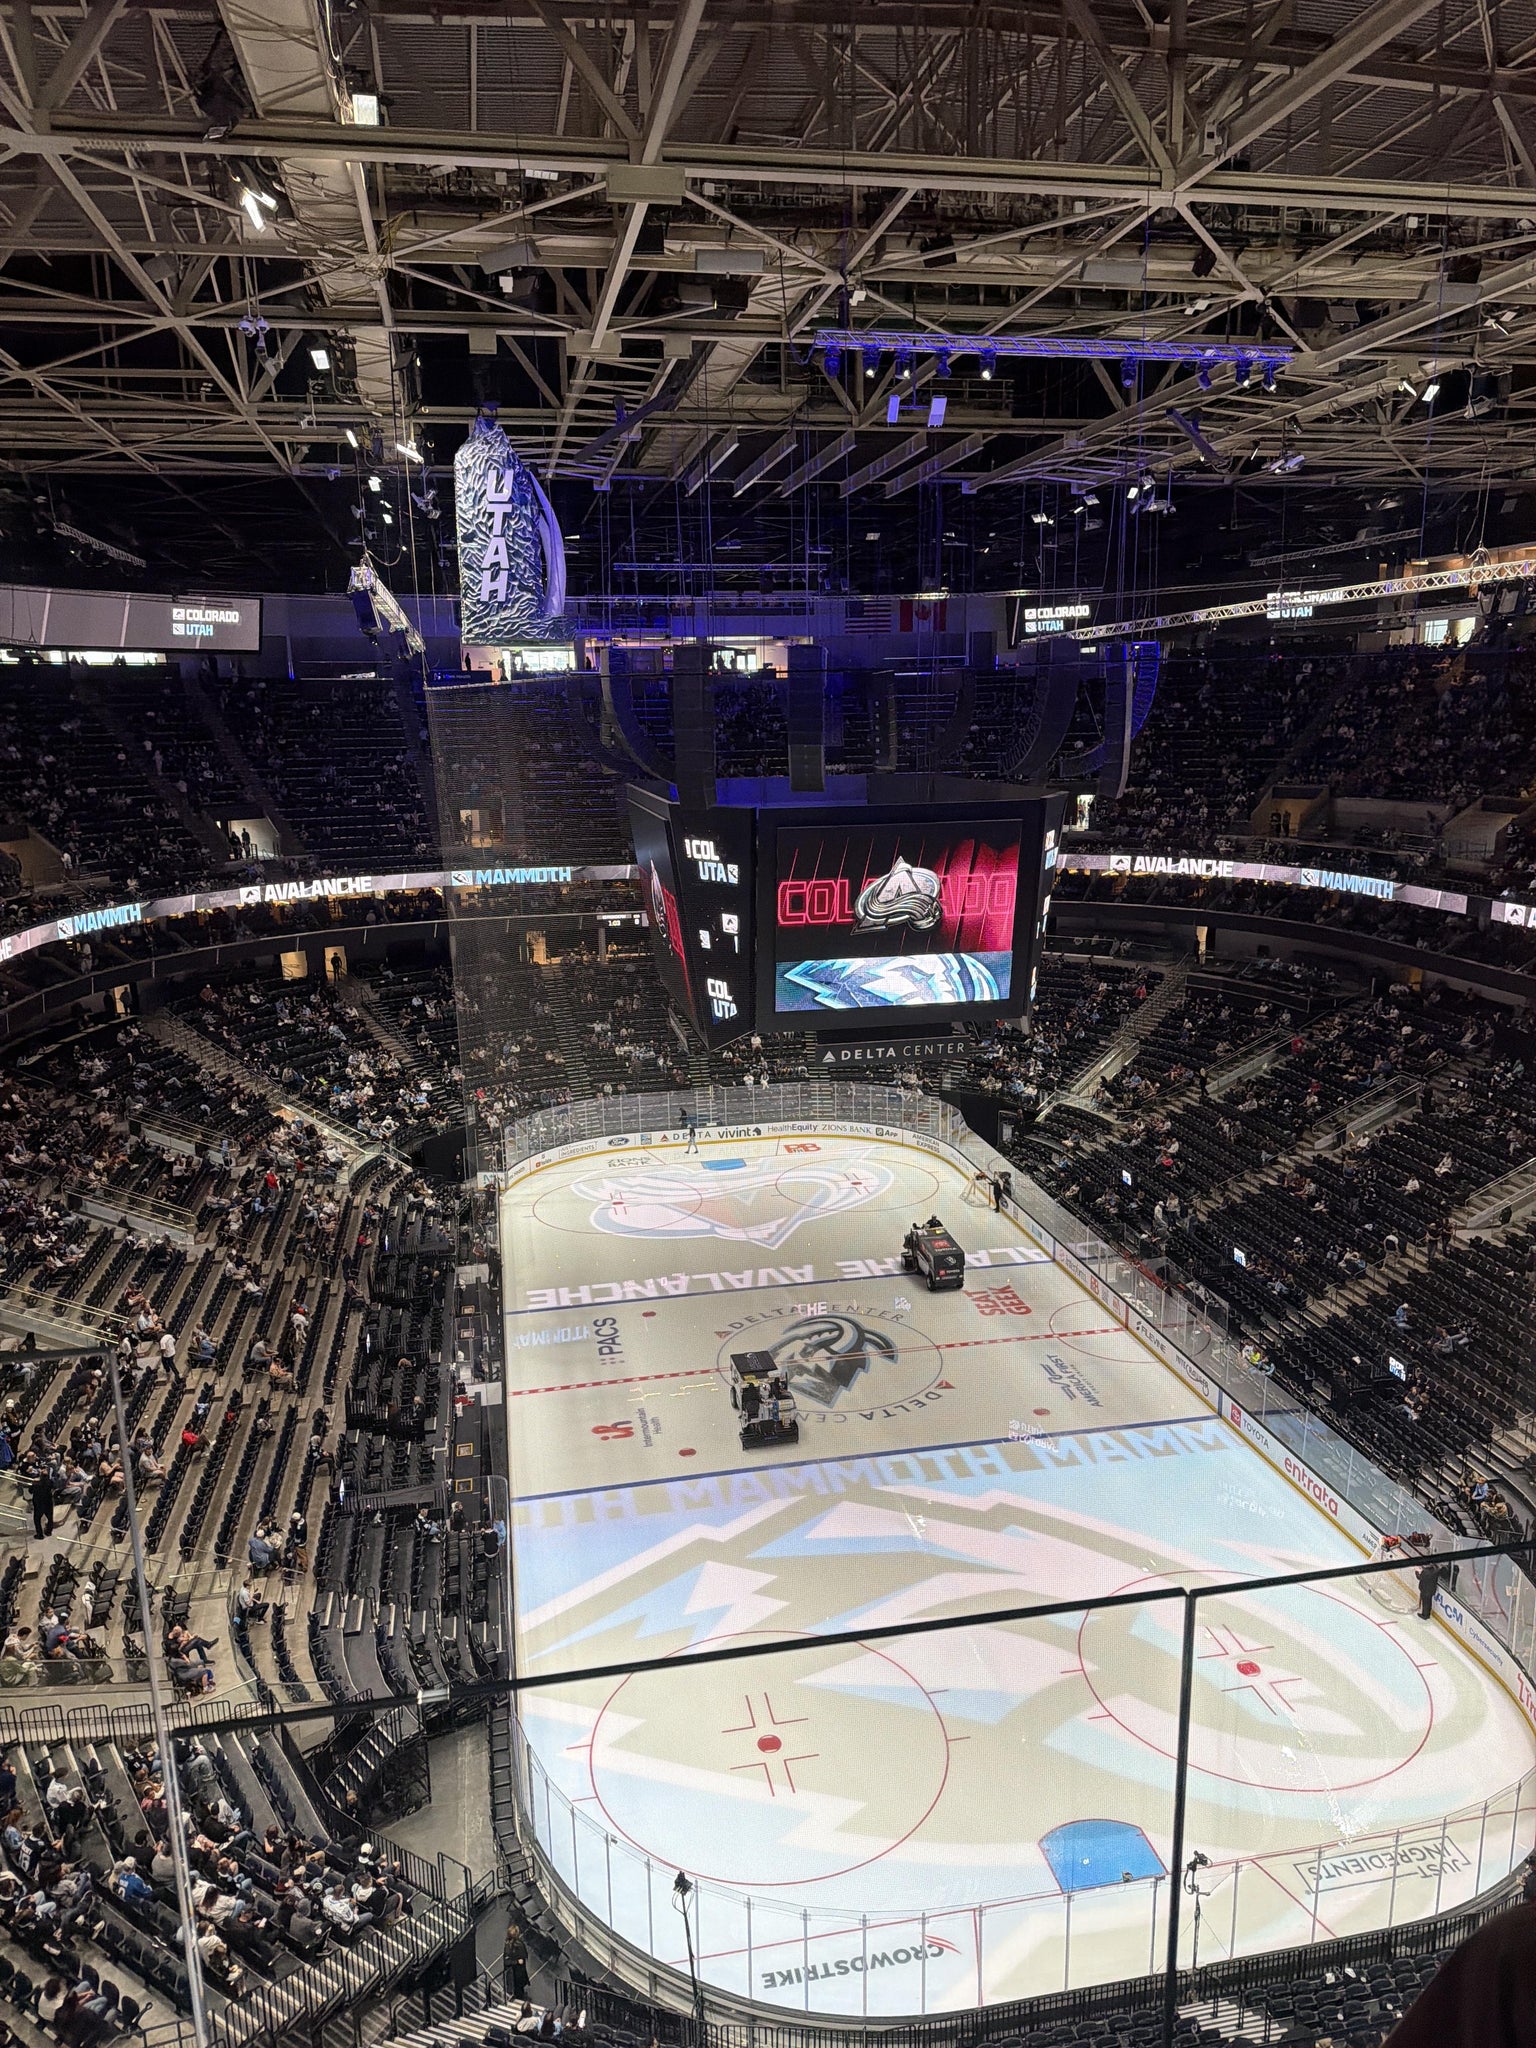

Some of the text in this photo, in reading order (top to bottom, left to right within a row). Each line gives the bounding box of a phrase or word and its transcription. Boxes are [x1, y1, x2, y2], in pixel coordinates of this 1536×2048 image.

[480, 469, 514, 601] UTAH
[186, 609, 240, 623] COLORADO
[1037, 605, 1090, 618] COLORADO
[1281, 606, 1313, 618] UTAH
[186, 624, 214, 636] UTAH
[1038, 620, 1064, 631] UTAH
[692, 840, 720, 861] COL
[476, 867, 571, 884] MAMMOTH
[699, 861, 728, 883] UTA
[1134, 857, 1234, 877] AVALANCHE
[264, 876, 372, 902] AVALANCHE
[1320, 871, 1394, 900] MAMMOTH
[778, 873, 1017, 925] COLADO
[74, 903, 141, 934] MAMMTH
[707, 978, 733, 1000] COL
[841, 1042, 965, 1060] DELTA CENTER
[672, 1131, 712, 1141] DETA
[850, 1126, 872, 1134] BANK
[527, 1264, 815, 1307] AVALANCHE
[962, 1290, 1006, 1317] SEAT
[988, 1284, 1032, 1316] GEEK
[593, 1317, 623, 1356] PACS
[1046, 1354, 1104, 1408] AMERICA FIRST
[859, 1391, 943, 1421] DELTA
[1243, 1419, 1270, 1450] TOYOTA
[1284, 1457, 1339, 1516] entrata
[1469, 1627, 1503, 1666] Cybersecurity
[1308, 1842, 1451, 1881] INGREDIENTS
[1417, 1858, 1461, 1879] JUST
[761, 1943, 945, 1989] CROWDSTRIKE
